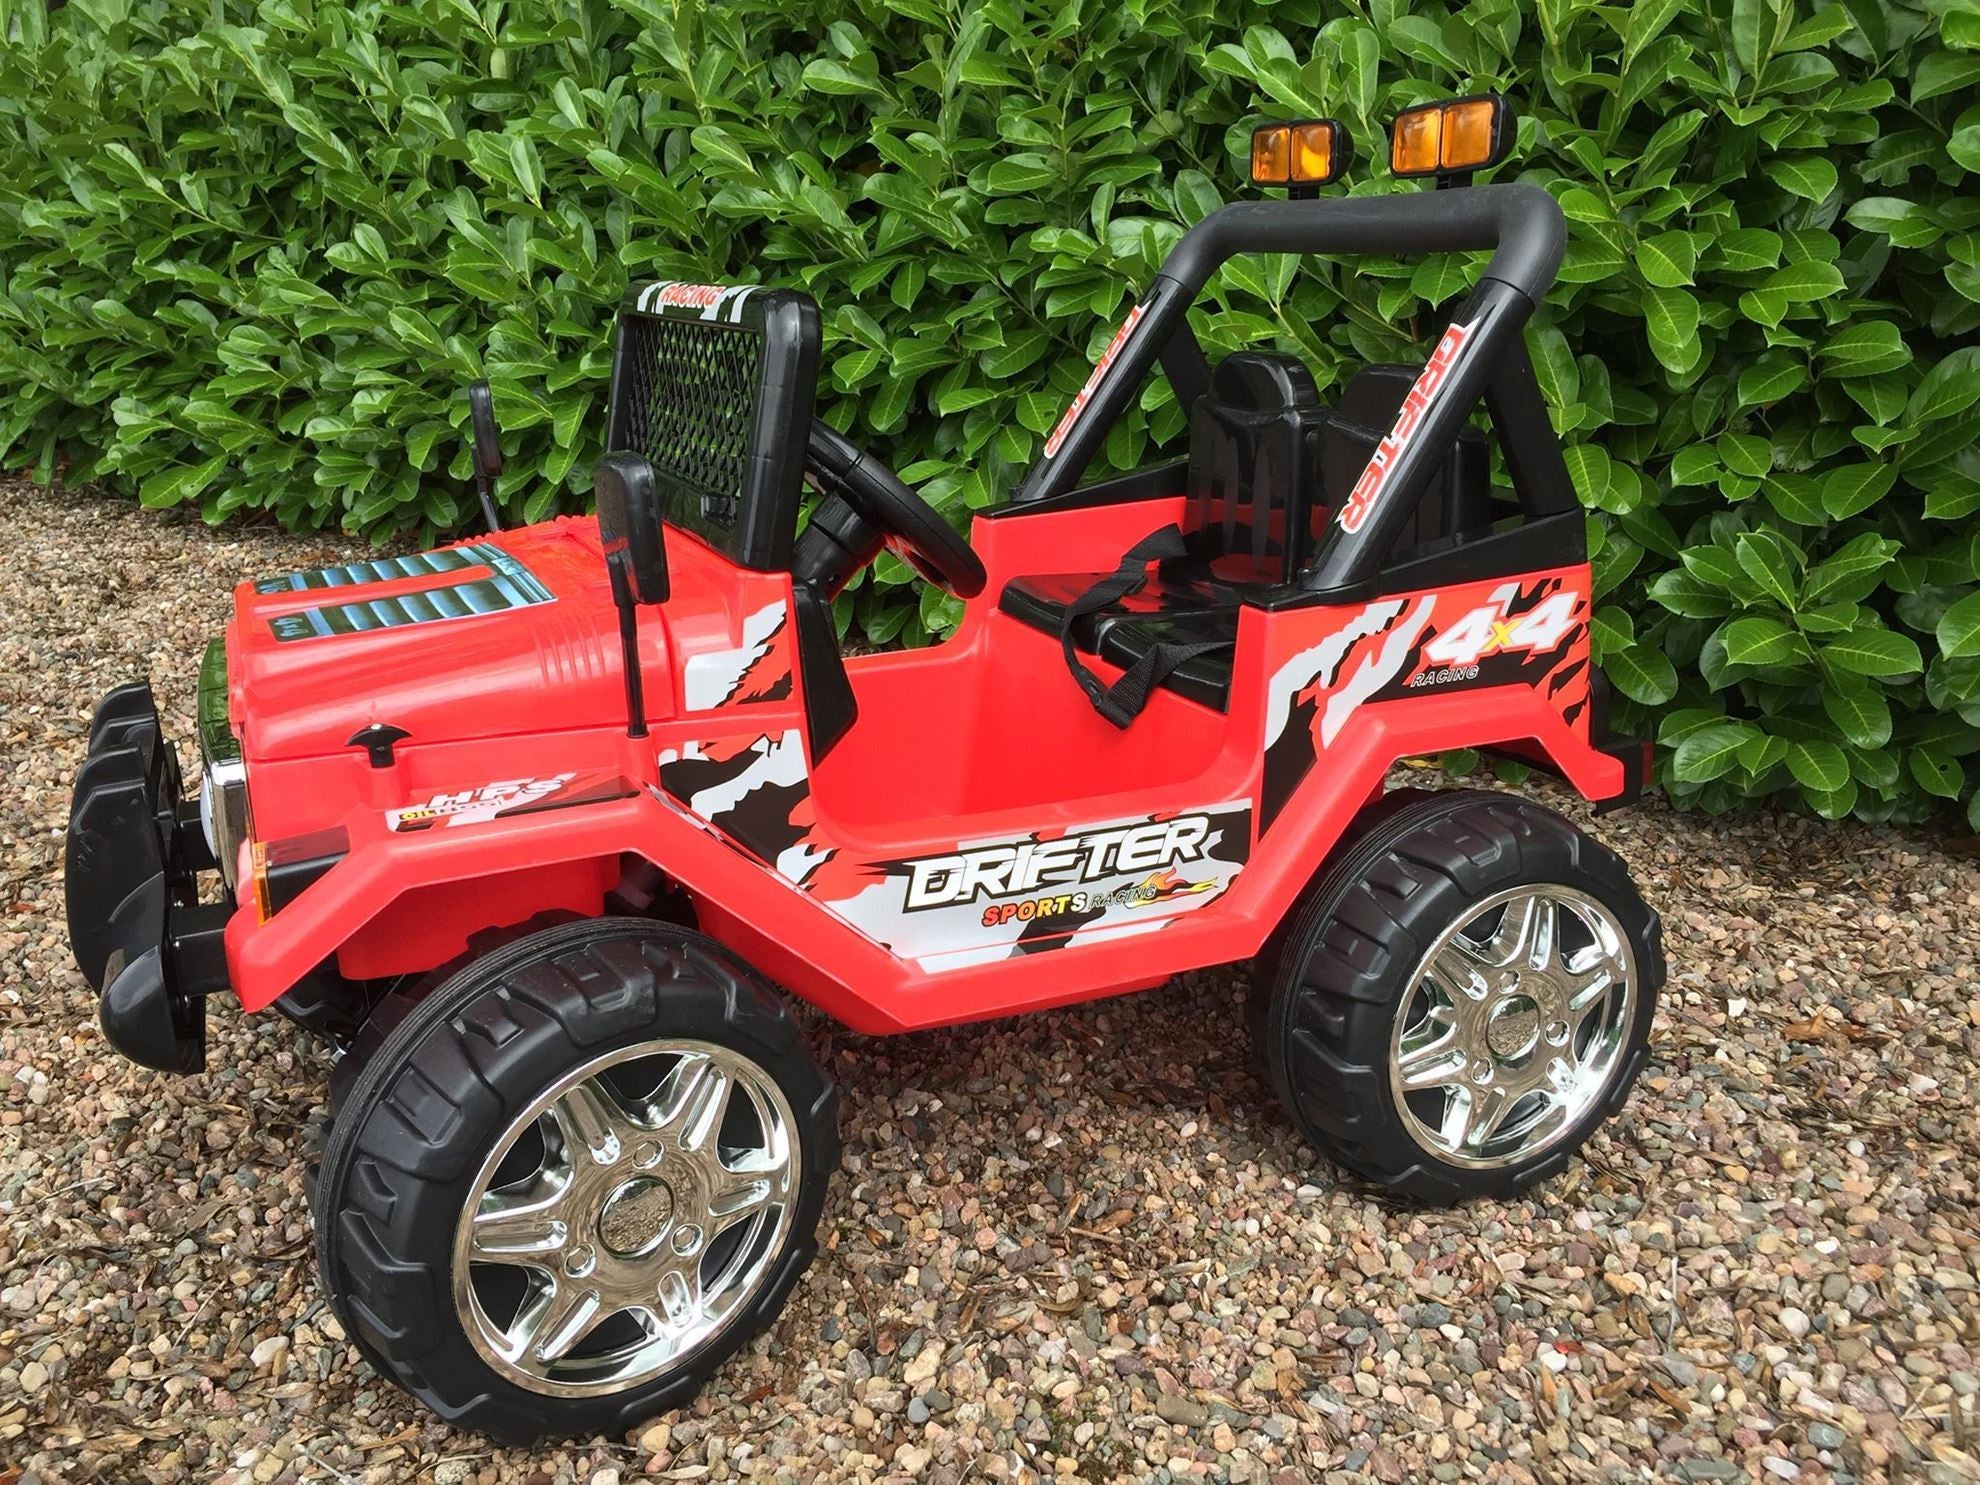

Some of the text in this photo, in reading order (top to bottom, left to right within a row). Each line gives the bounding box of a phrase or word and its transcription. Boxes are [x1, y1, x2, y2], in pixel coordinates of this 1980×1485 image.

[661, 283, 726, 309] RACING
[1338, 324, 1467, 532] DRIFTER
[1425, 591, 1579, 665] 4x4
[1410, 665, 1479, 687] RACING
[902, 816, 1209, 909] DRIFTER
[981, 883, 1157, 927] SPORTS RACING
